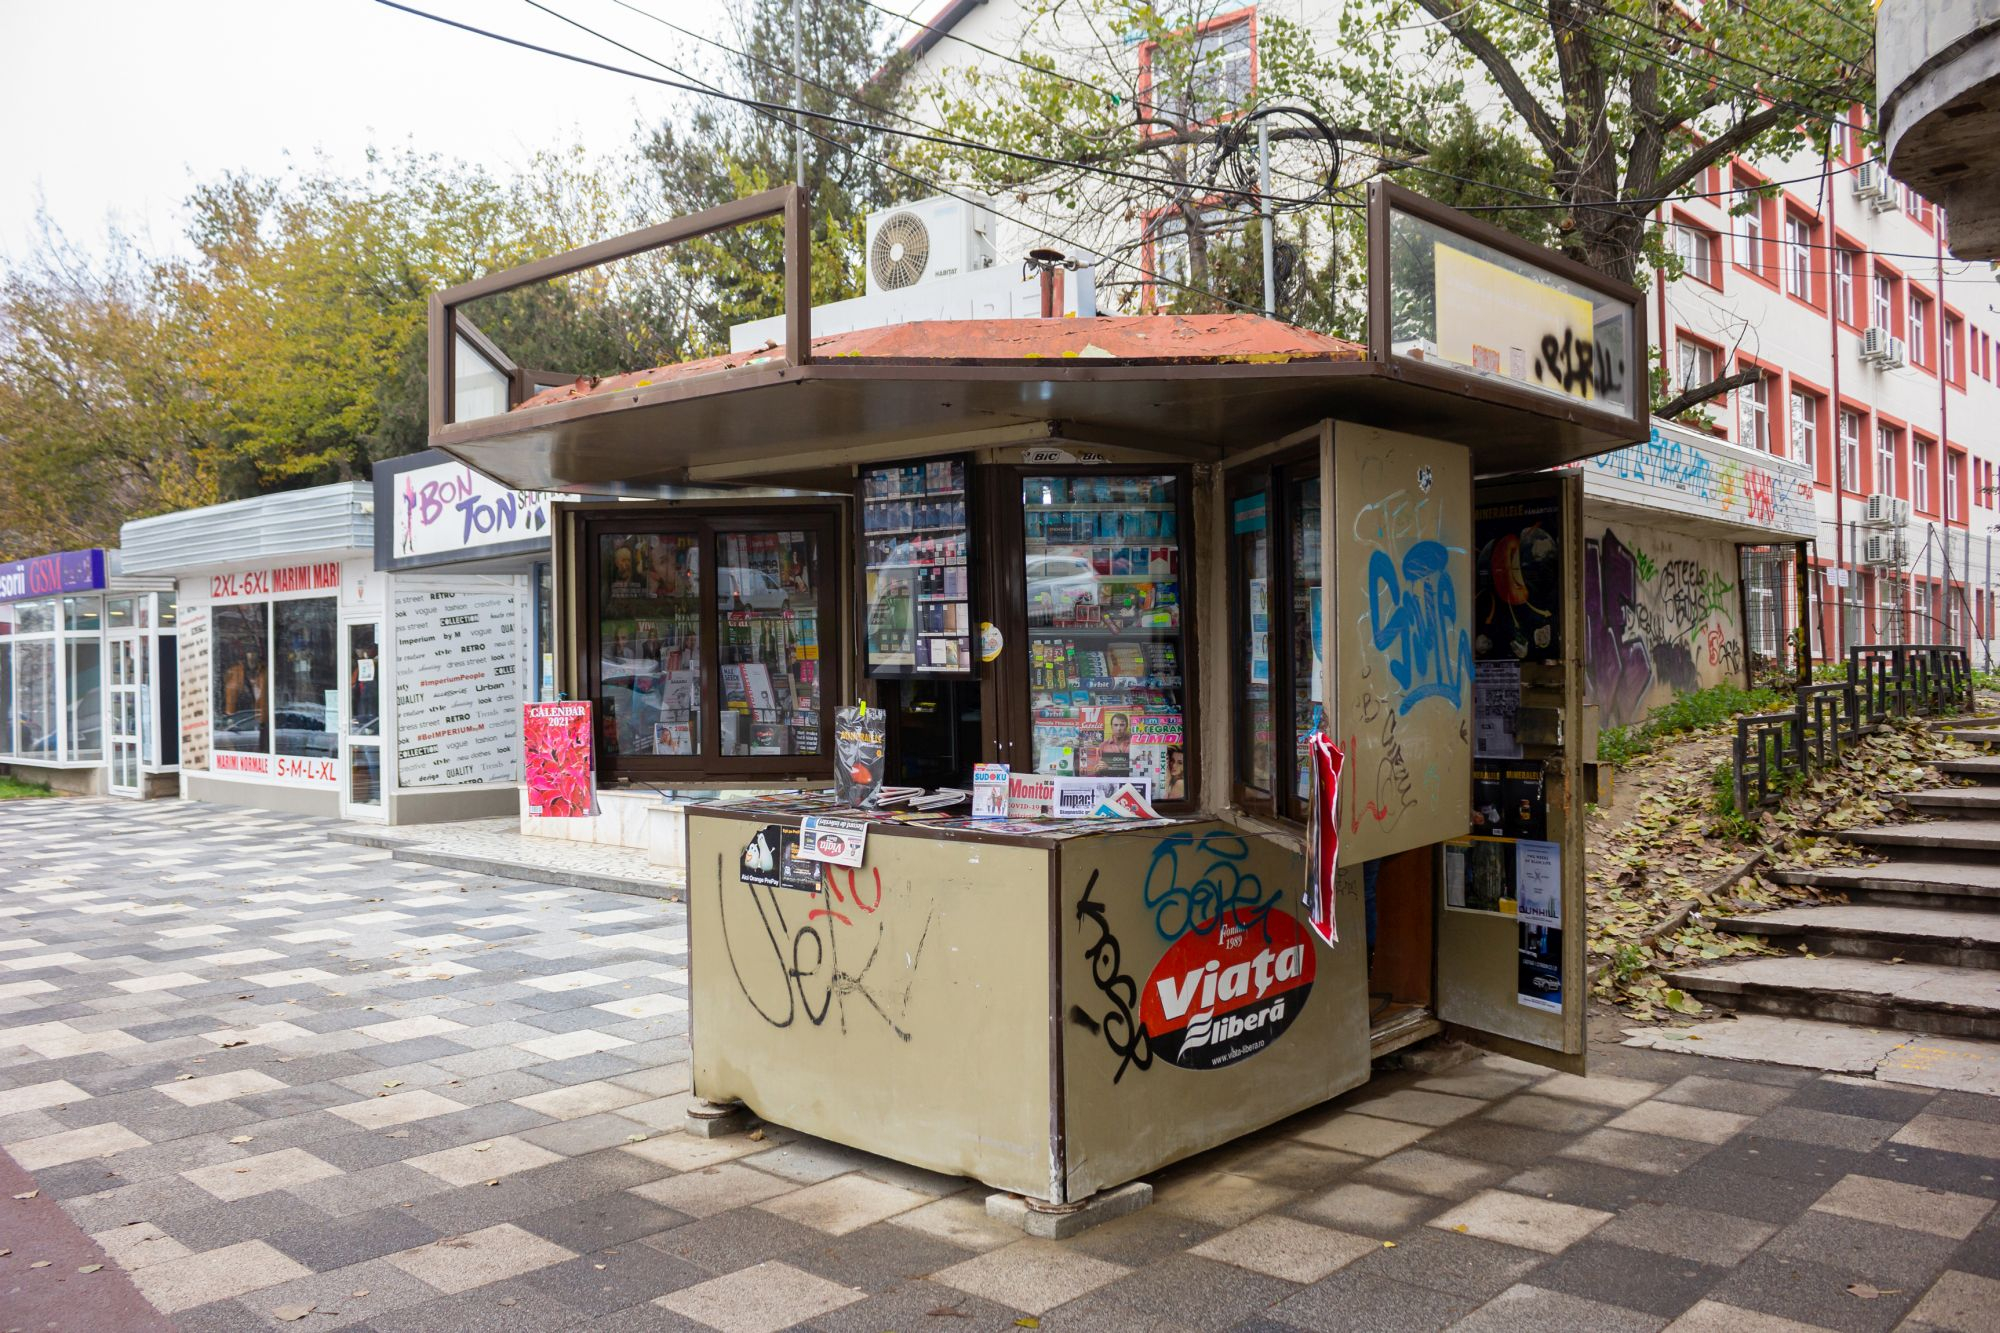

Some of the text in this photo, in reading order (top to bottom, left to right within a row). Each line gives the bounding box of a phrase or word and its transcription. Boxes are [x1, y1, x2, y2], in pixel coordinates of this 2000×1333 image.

[420, 467, 473, 527] BON
[455, 492, 517, 545] TON
[0, 564, 25, 597] sorii
[29, 556, 62, 593] GSM
[211, 570, 269, 598] 2XL-6XL
[272, 562, 340, 593] MARIMI MARI
[443, 632, 452, 641] by
[454, 631, 461, 639] M
[460, 643, 486, 654] RETRO
[475, 682, 505, 692] Urban
[445, 713, 471, 724] RETRO
[529, 706, 586, 718] CALENDAR
[548, 716, 570, 726] 2021
[1082, 707, 1102, 723] TV
[1060, 788, 1096, 809] Impact
[1210, 998, 1285, 1046] liberă
